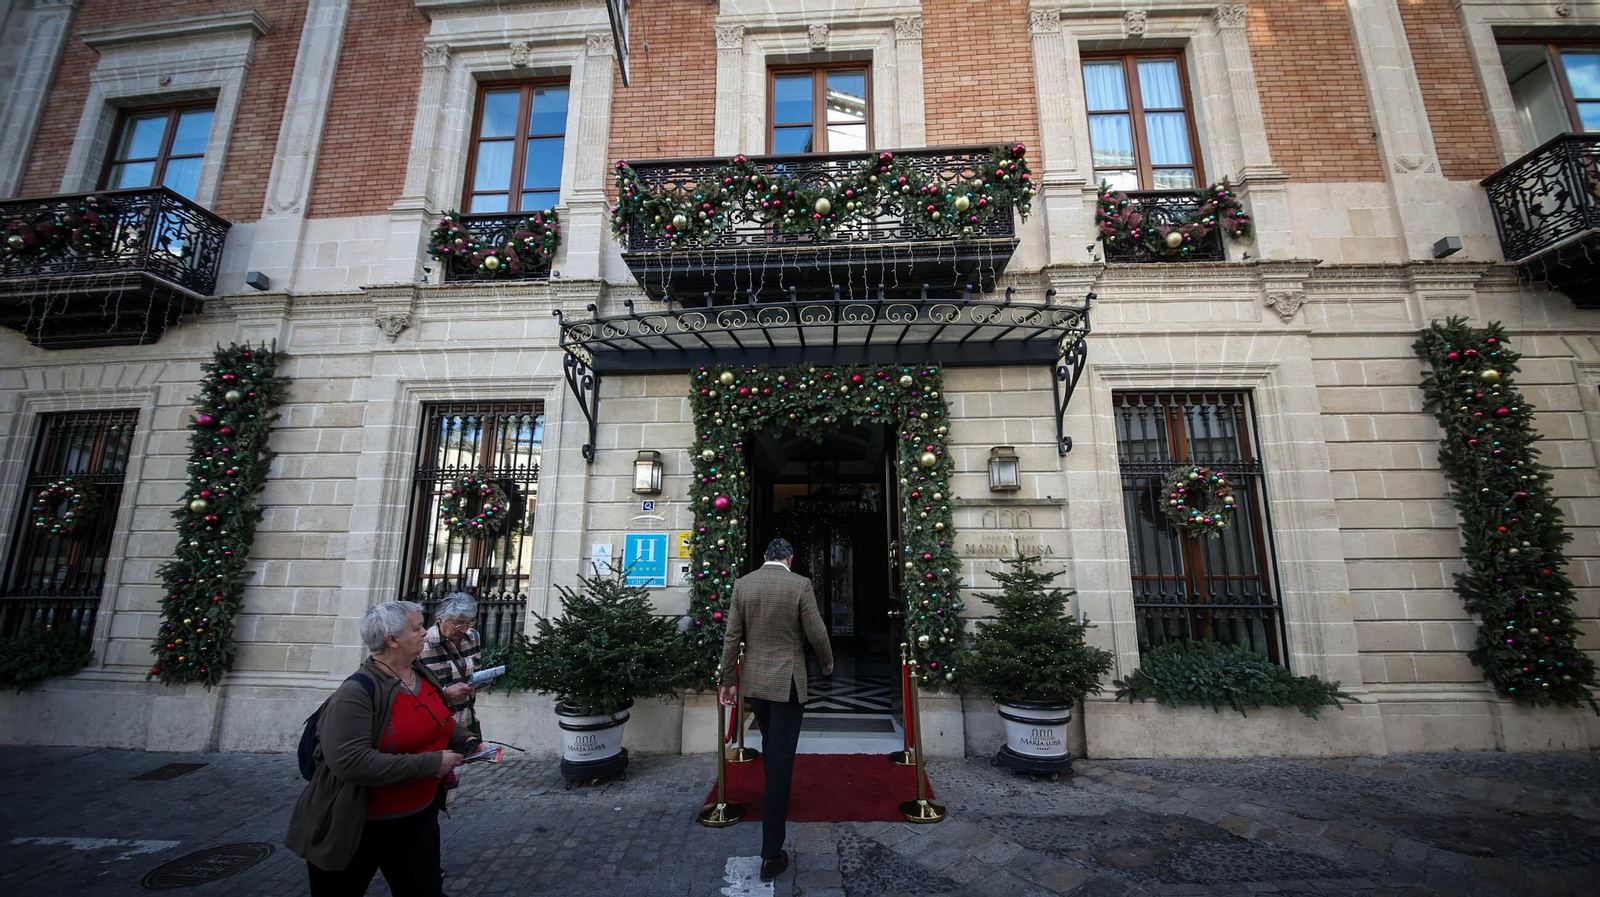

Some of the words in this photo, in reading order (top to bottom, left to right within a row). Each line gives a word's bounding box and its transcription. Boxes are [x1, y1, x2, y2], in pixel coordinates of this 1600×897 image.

[644, 502, 653, 510] Q
[634, 538, 658, 562] H
[1016, 544, 1053, 554] UISA
